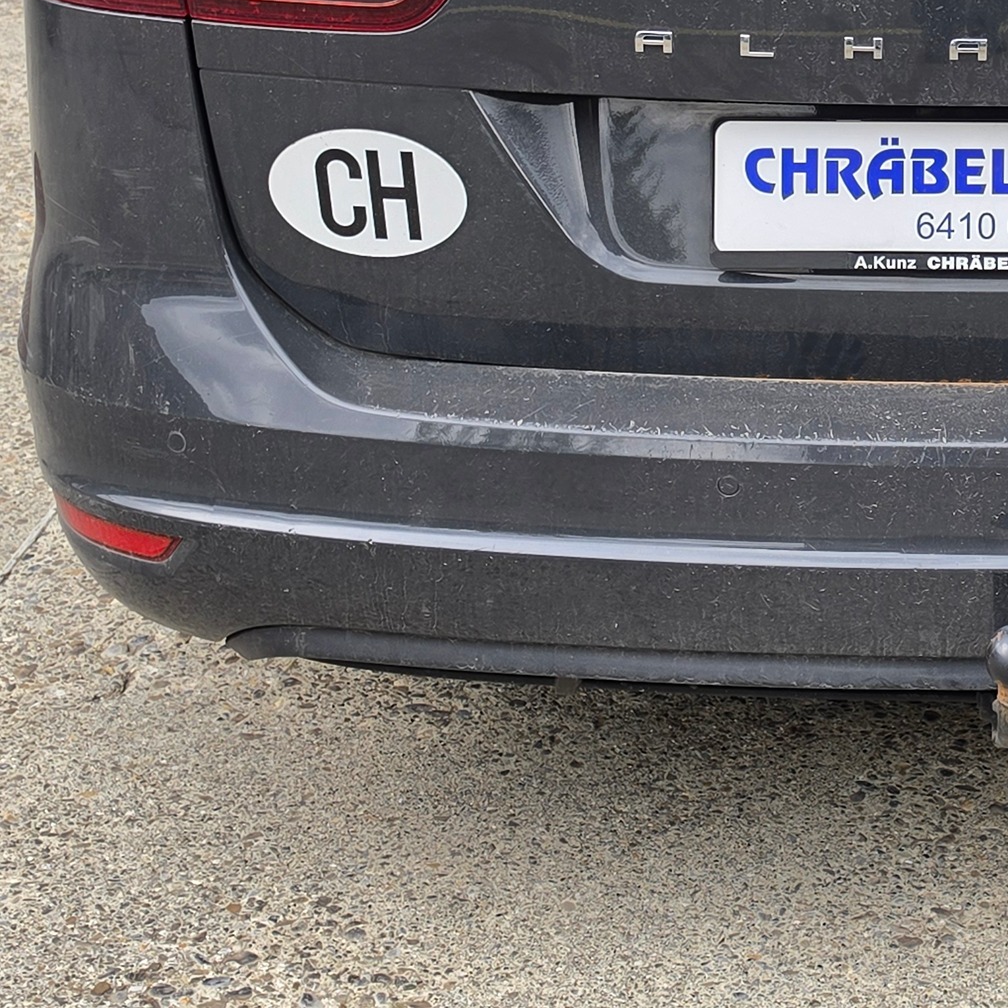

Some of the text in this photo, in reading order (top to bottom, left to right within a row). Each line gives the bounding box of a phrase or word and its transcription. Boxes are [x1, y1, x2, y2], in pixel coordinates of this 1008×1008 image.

[315, 148, 423, 241] CH
[916, 211, 996, 240] 6410
[853, 255, 917, 271] A.Kunz
